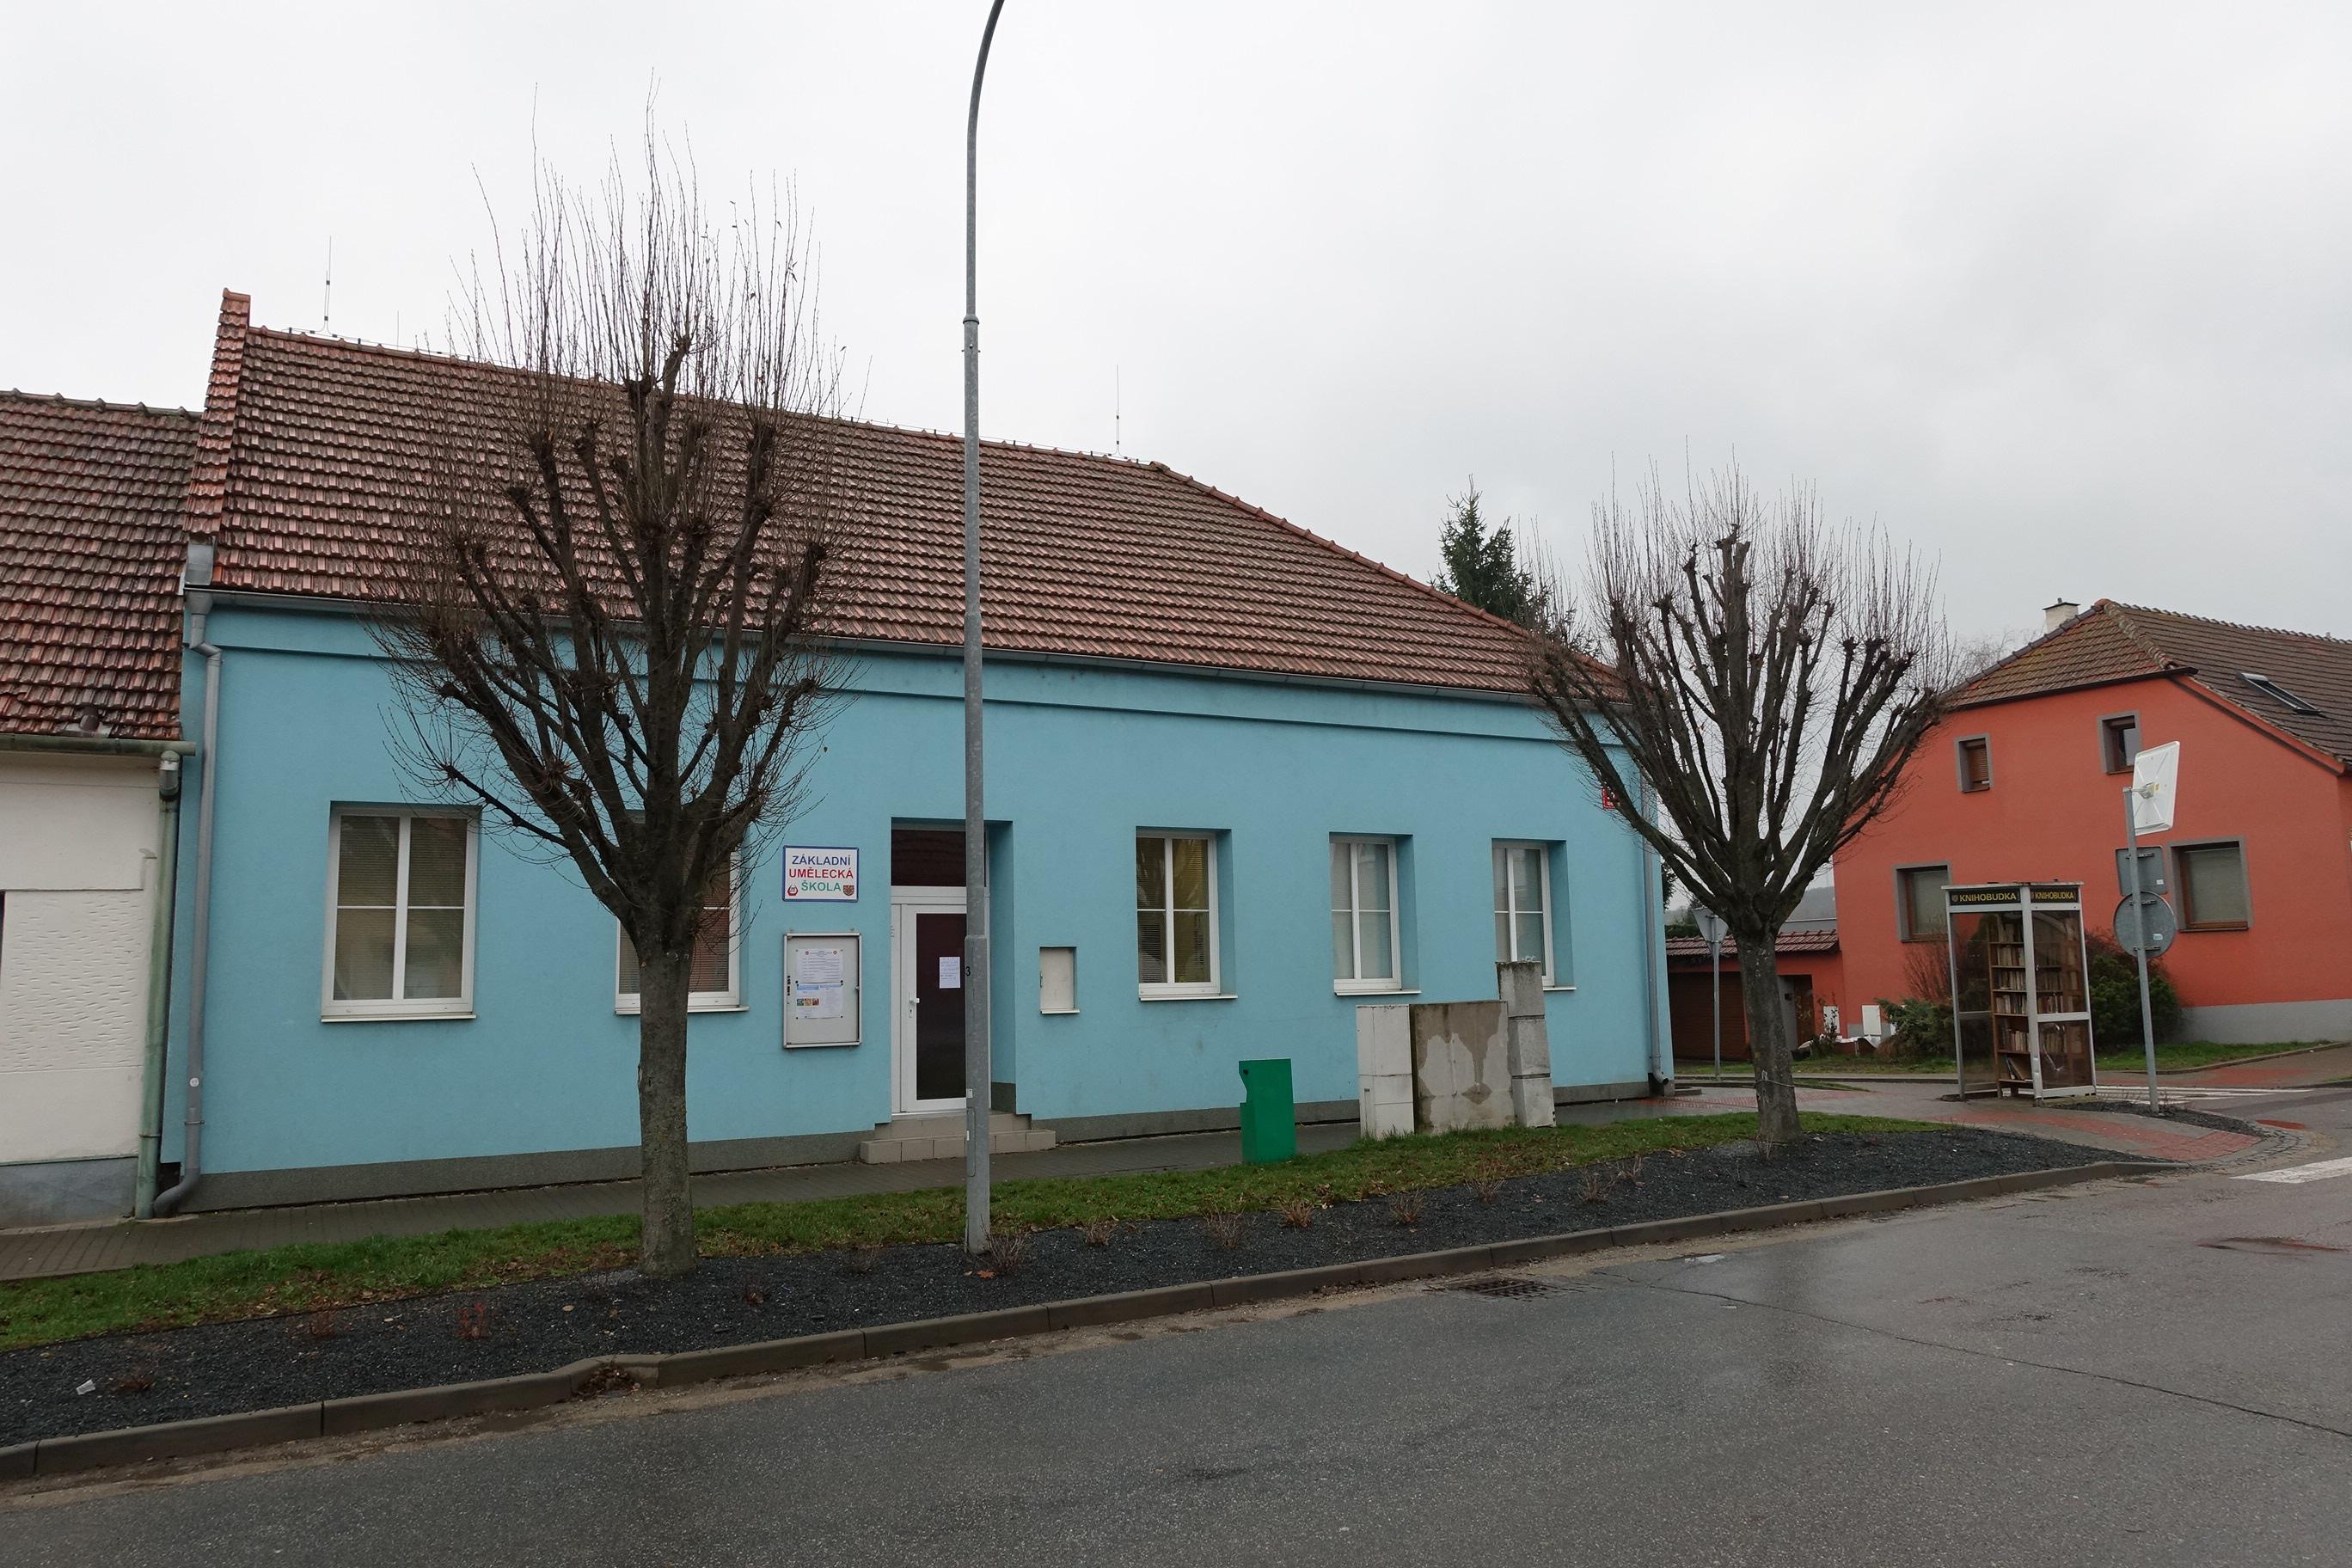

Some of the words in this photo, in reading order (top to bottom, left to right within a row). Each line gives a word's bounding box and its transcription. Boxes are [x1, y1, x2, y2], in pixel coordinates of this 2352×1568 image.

[792, 854, 851, 866] ZÁKLADNÍ
[789, 867, 854, 879] UMĚLECKÁ
[801, 879, 842, 891] ŠKOLA
[1959, 892, 2017, 902] KNIHOBUDKA
